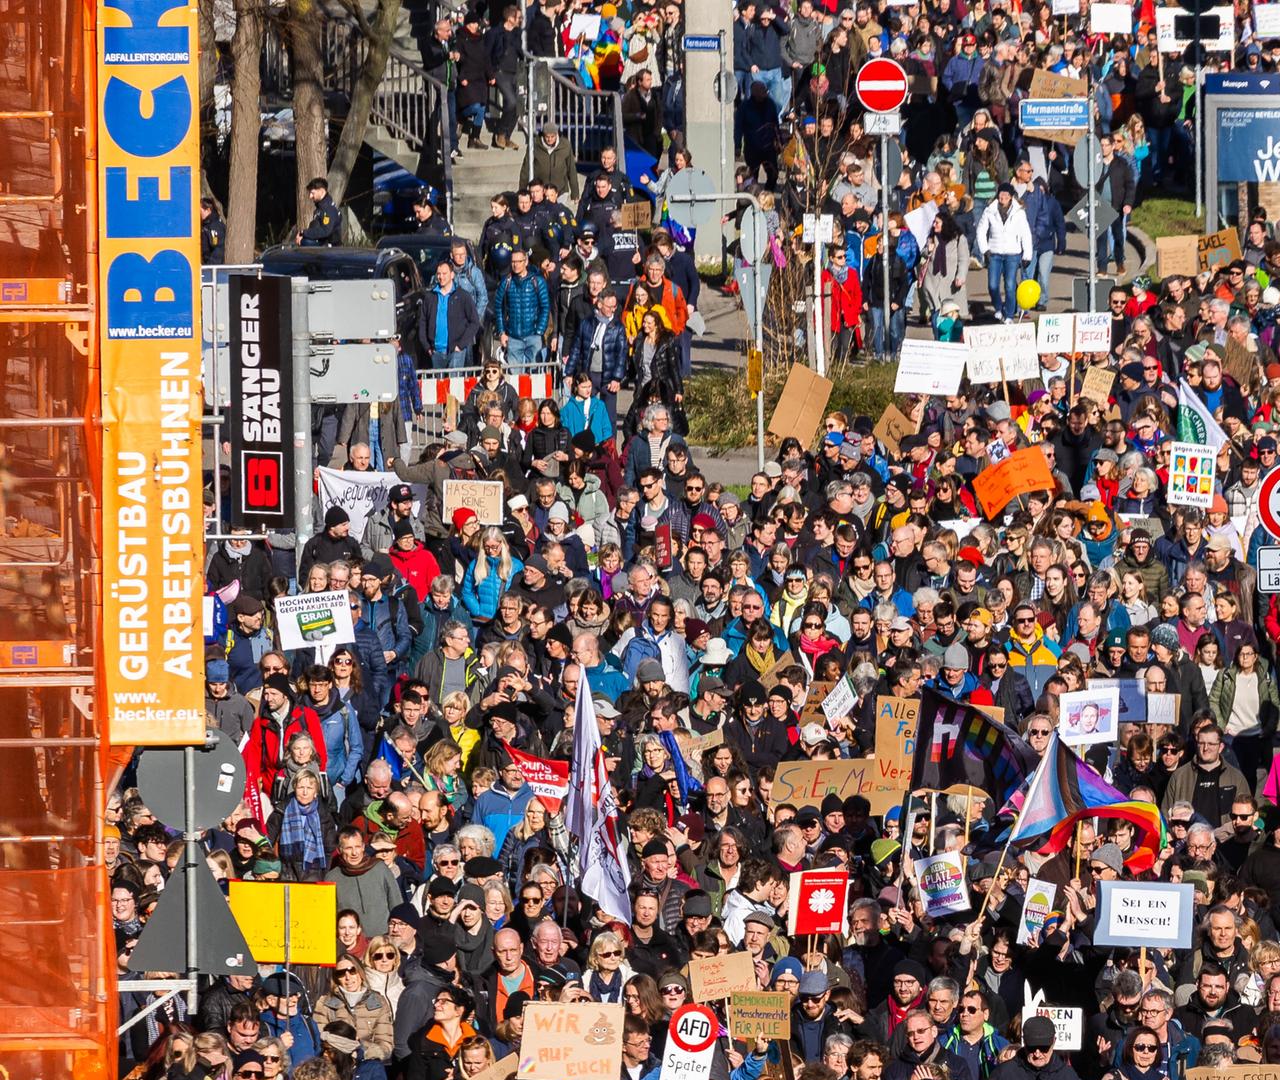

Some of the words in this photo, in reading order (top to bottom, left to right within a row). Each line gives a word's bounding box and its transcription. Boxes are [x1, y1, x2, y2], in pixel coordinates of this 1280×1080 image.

[104, 52, 189, 62] ABFALLENTSORGUNG
[109, 326, 192, 338] www.becker.eu
[241, 293, 260, 441] SÄNGER
[261, 368, 281, 442] BAU
[160, 351, 192, 679] ARBEITSBÜHNEN
[112, 450, 149, 680] GERÜSTBAU
[114, 706, 199, 722] becker.eu
[881, 703, 916, 720] Alle
[925, 870, 951, 885] PLATZ
[678, 1018, 710, 1039] AFD
[755, 1022, 780, 1035] ALLE
